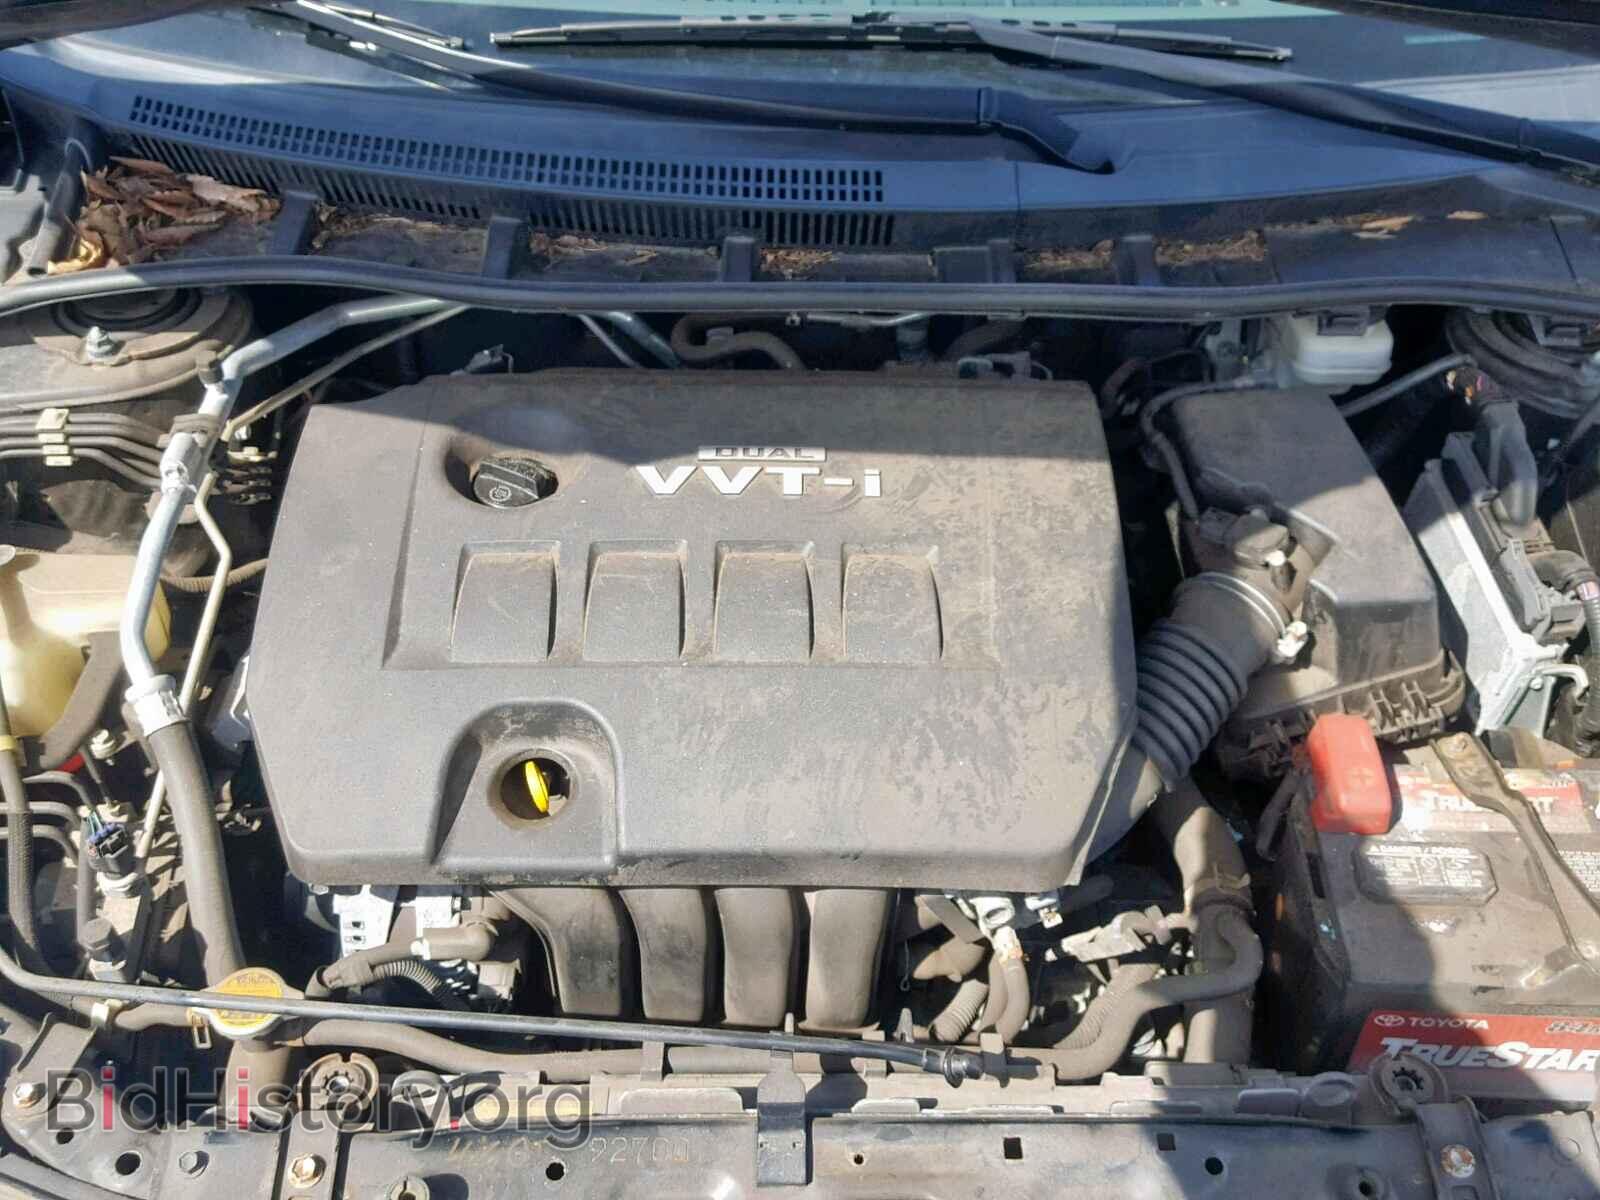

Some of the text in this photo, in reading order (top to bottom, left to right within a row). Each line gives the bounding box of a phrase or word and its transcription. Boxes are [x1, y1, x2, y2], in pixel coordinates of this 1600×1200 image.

[714, 446, 815, 459] DUAL
[636, 465, 881, 497] VVT-i
[1409, 1017, 1489, 1030] TOYOTA
